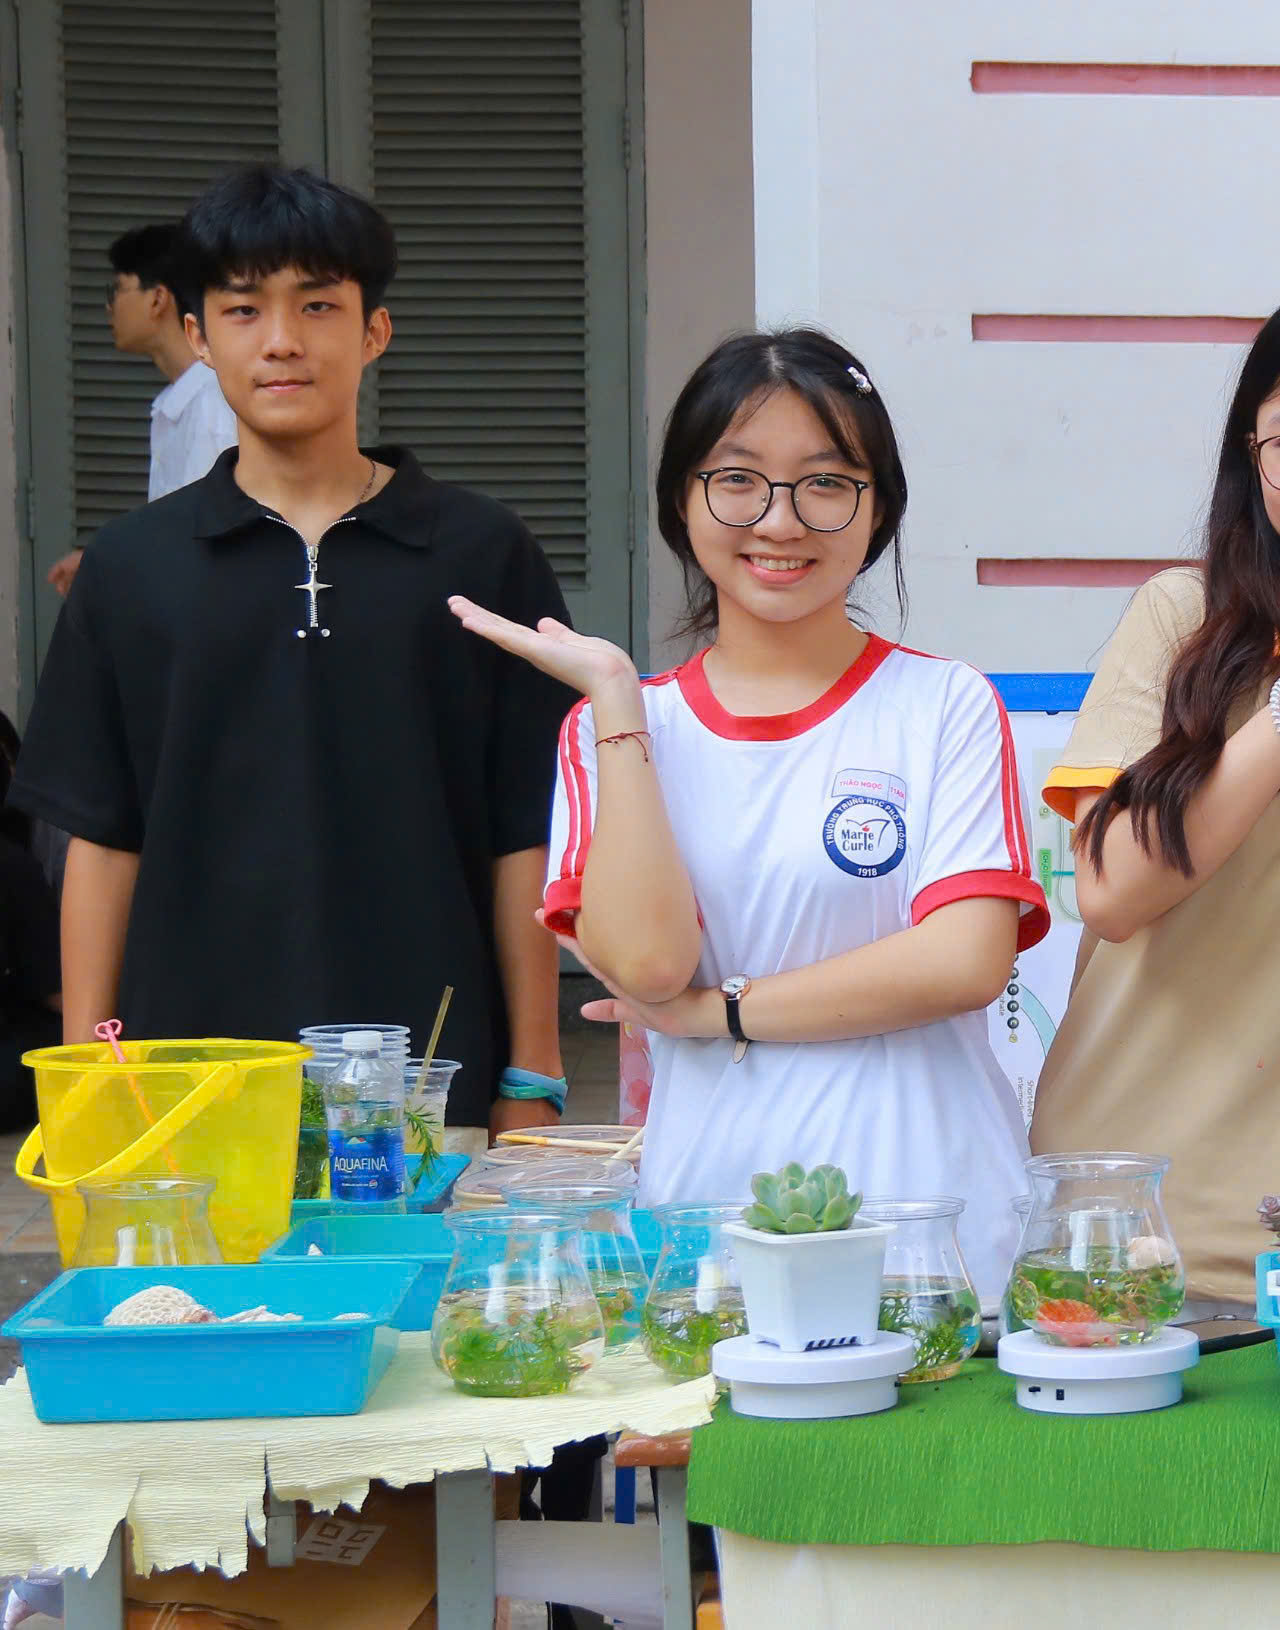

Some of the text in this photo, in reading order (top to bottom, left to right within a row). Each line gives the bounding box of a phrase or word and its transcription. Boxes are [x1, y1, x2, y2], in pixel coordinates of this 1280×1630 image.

[839, 797, 865, 813] TRUNG
[841, 828, 875, 840] Marie
[842, 840, 874, 851] Curie
[857, 867, 878, 877] 1918
[334, 1156, 388, 1173] AQUAFINA
